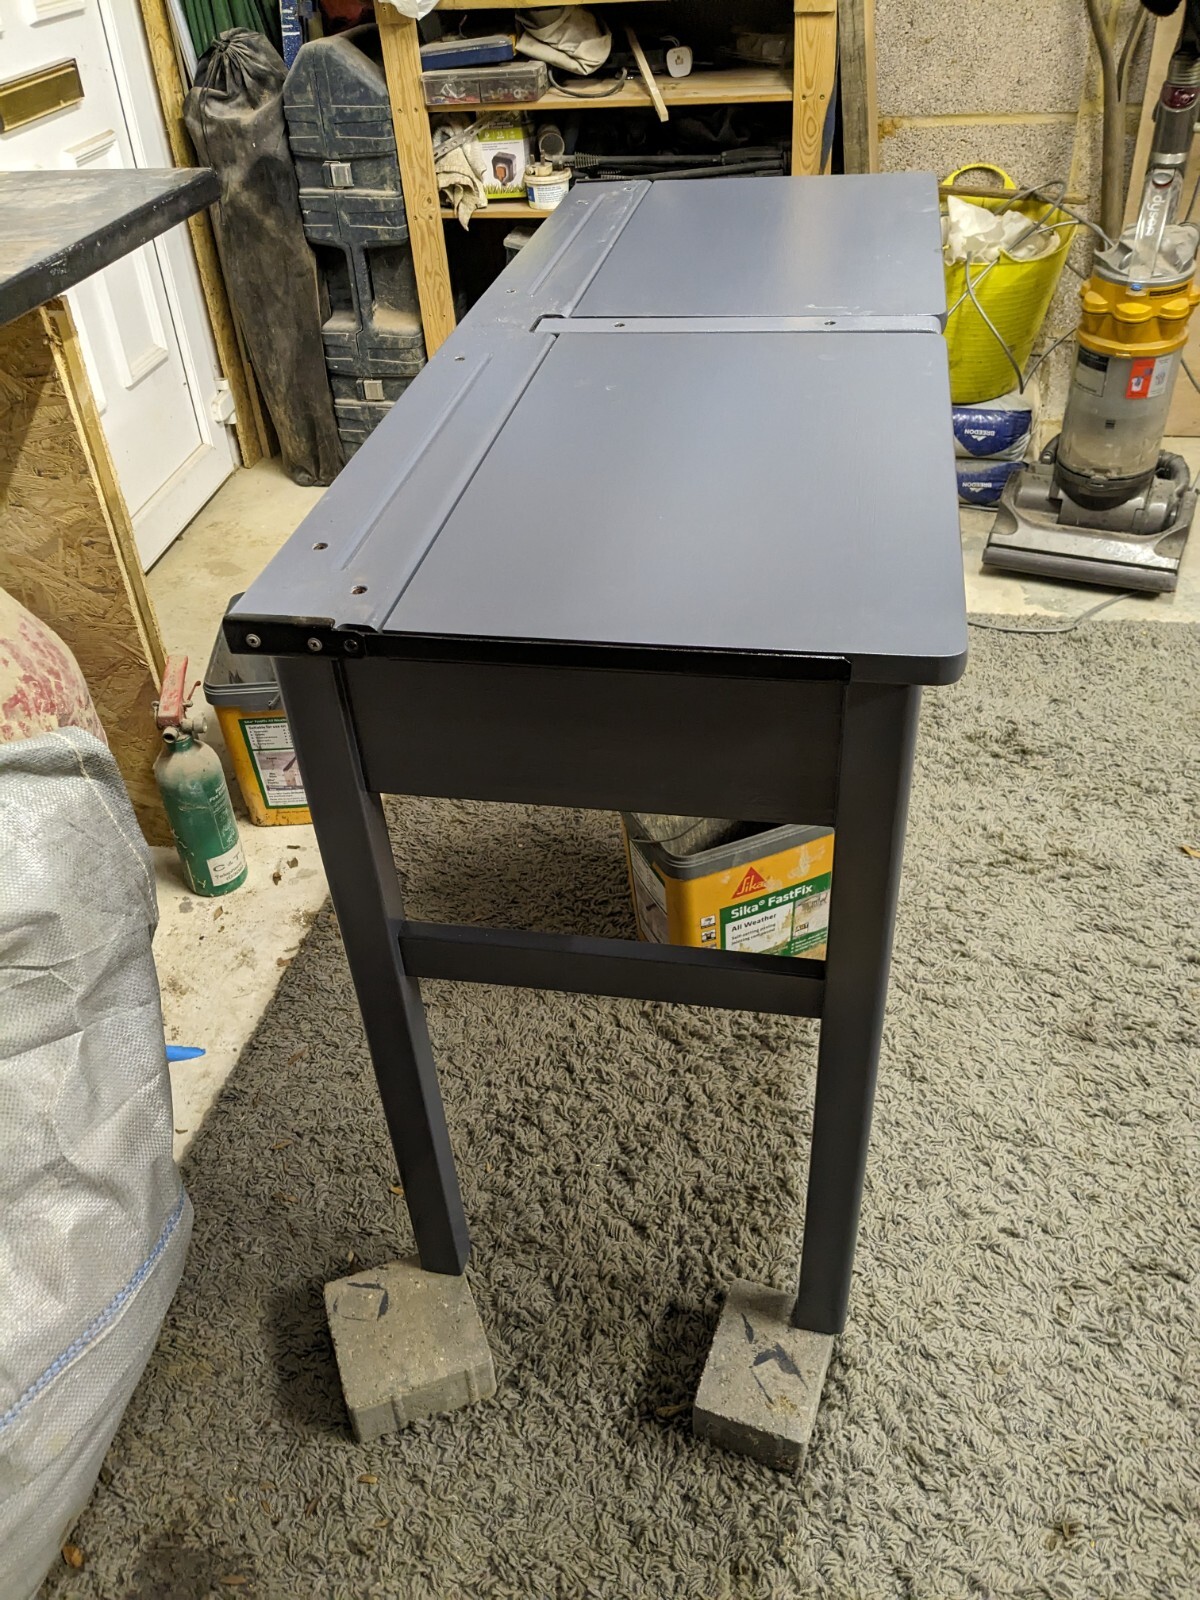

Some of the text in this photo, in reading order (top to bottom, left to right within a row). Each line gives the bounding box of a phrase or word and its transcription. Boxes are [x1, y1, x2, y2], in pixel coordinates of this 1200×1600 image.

[1145, 196, 1166, 236] dyson
[213, 865, 225, 873] C
[736, 875, 767, 895] Sika
[767, 884, 813, 907] FastFix
[731, 913, 777, 932] All Weather
